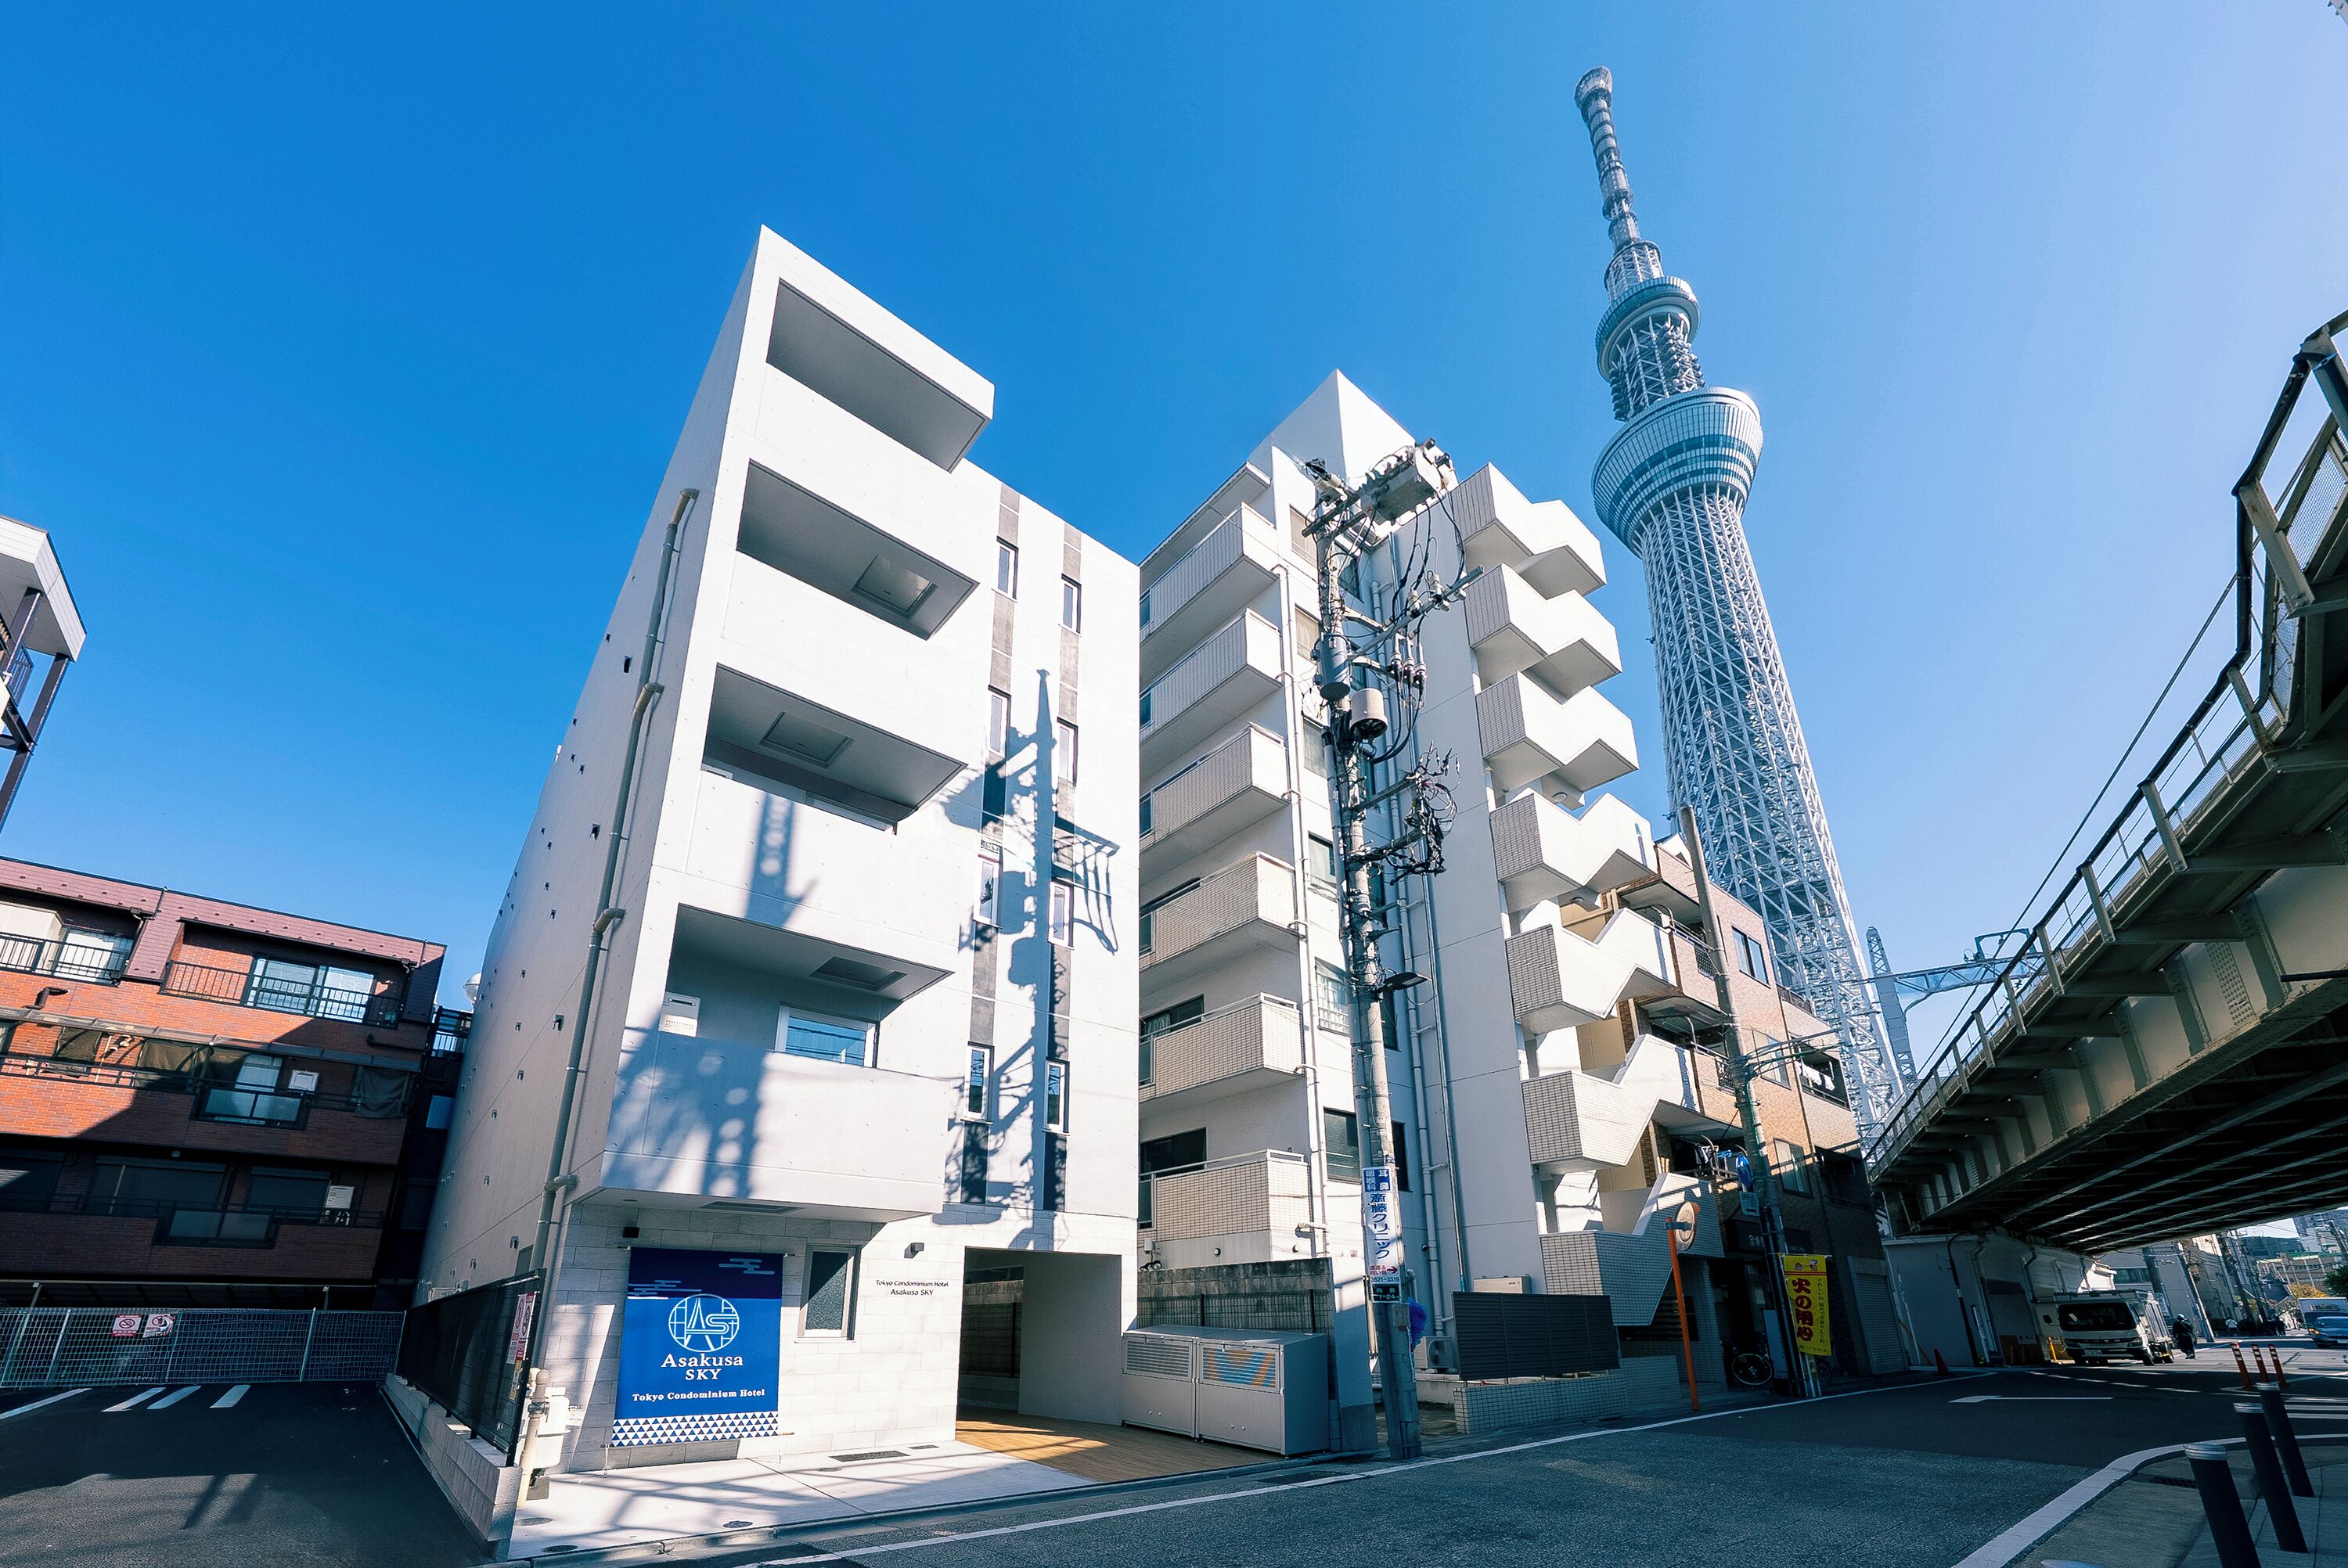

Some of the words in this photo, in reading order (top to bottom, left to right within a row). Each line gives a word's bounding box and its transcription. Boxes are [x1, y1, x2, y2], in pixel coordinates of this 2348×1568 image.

[1792, 1278, 1813, 1341] 火の用心
[661, 1353, 744, 1368] Asakusa
[685, 1368, 722, 1380] SKY
[632, 1394, 664, 1402] Tokyo
[667, 1390, 737, 1400] Condominium
